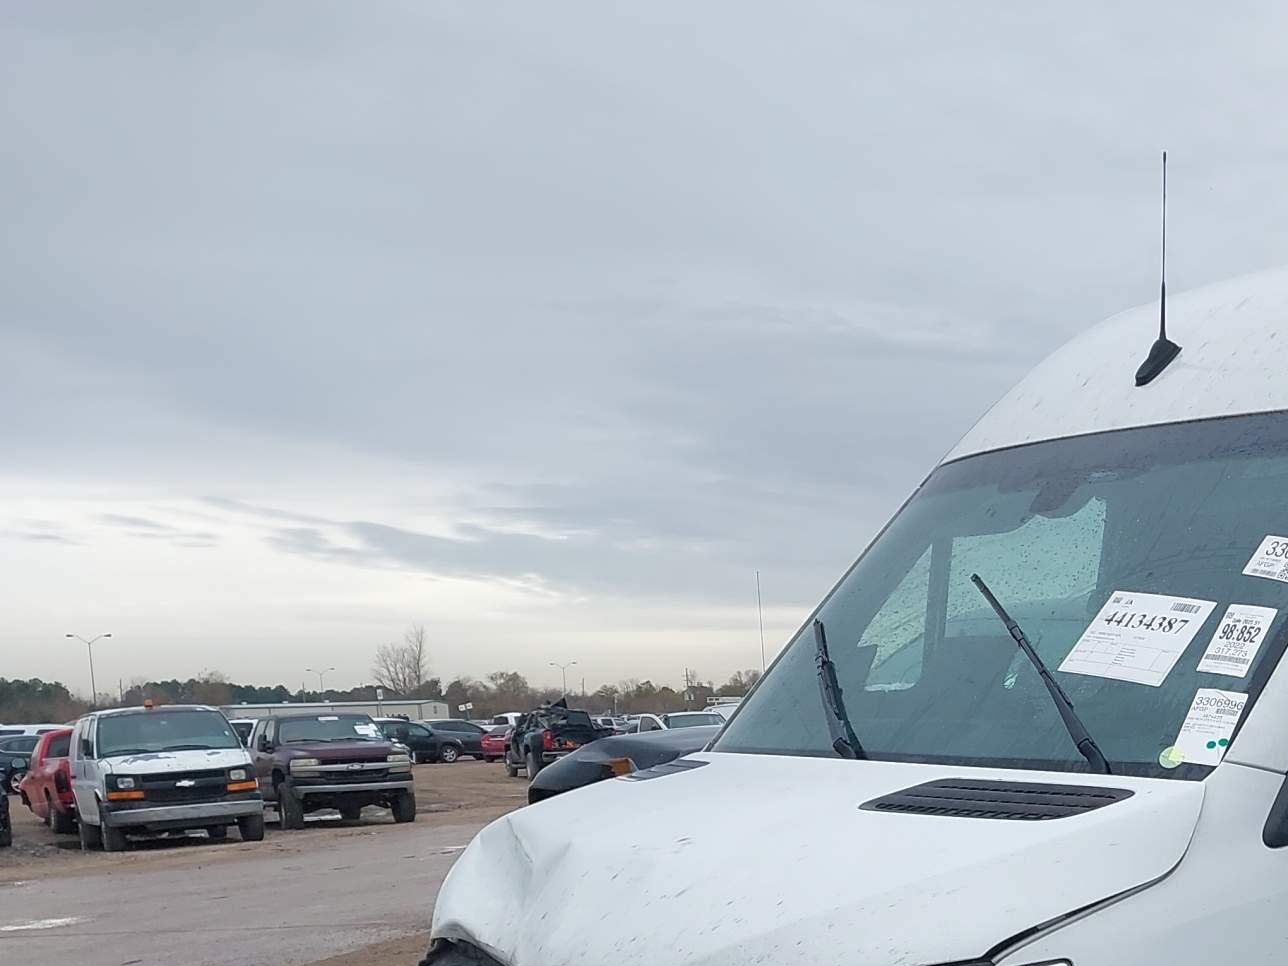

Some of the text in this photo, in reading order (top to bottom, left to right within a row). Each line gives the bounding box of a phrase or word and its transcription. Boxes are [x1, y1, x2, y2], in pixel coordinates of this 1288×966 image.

[1104, 611, 1190, 634] 44134387
[1219, 623, 1261, 643] 98:852
[1195, 696, 1245, 711] 3306996
